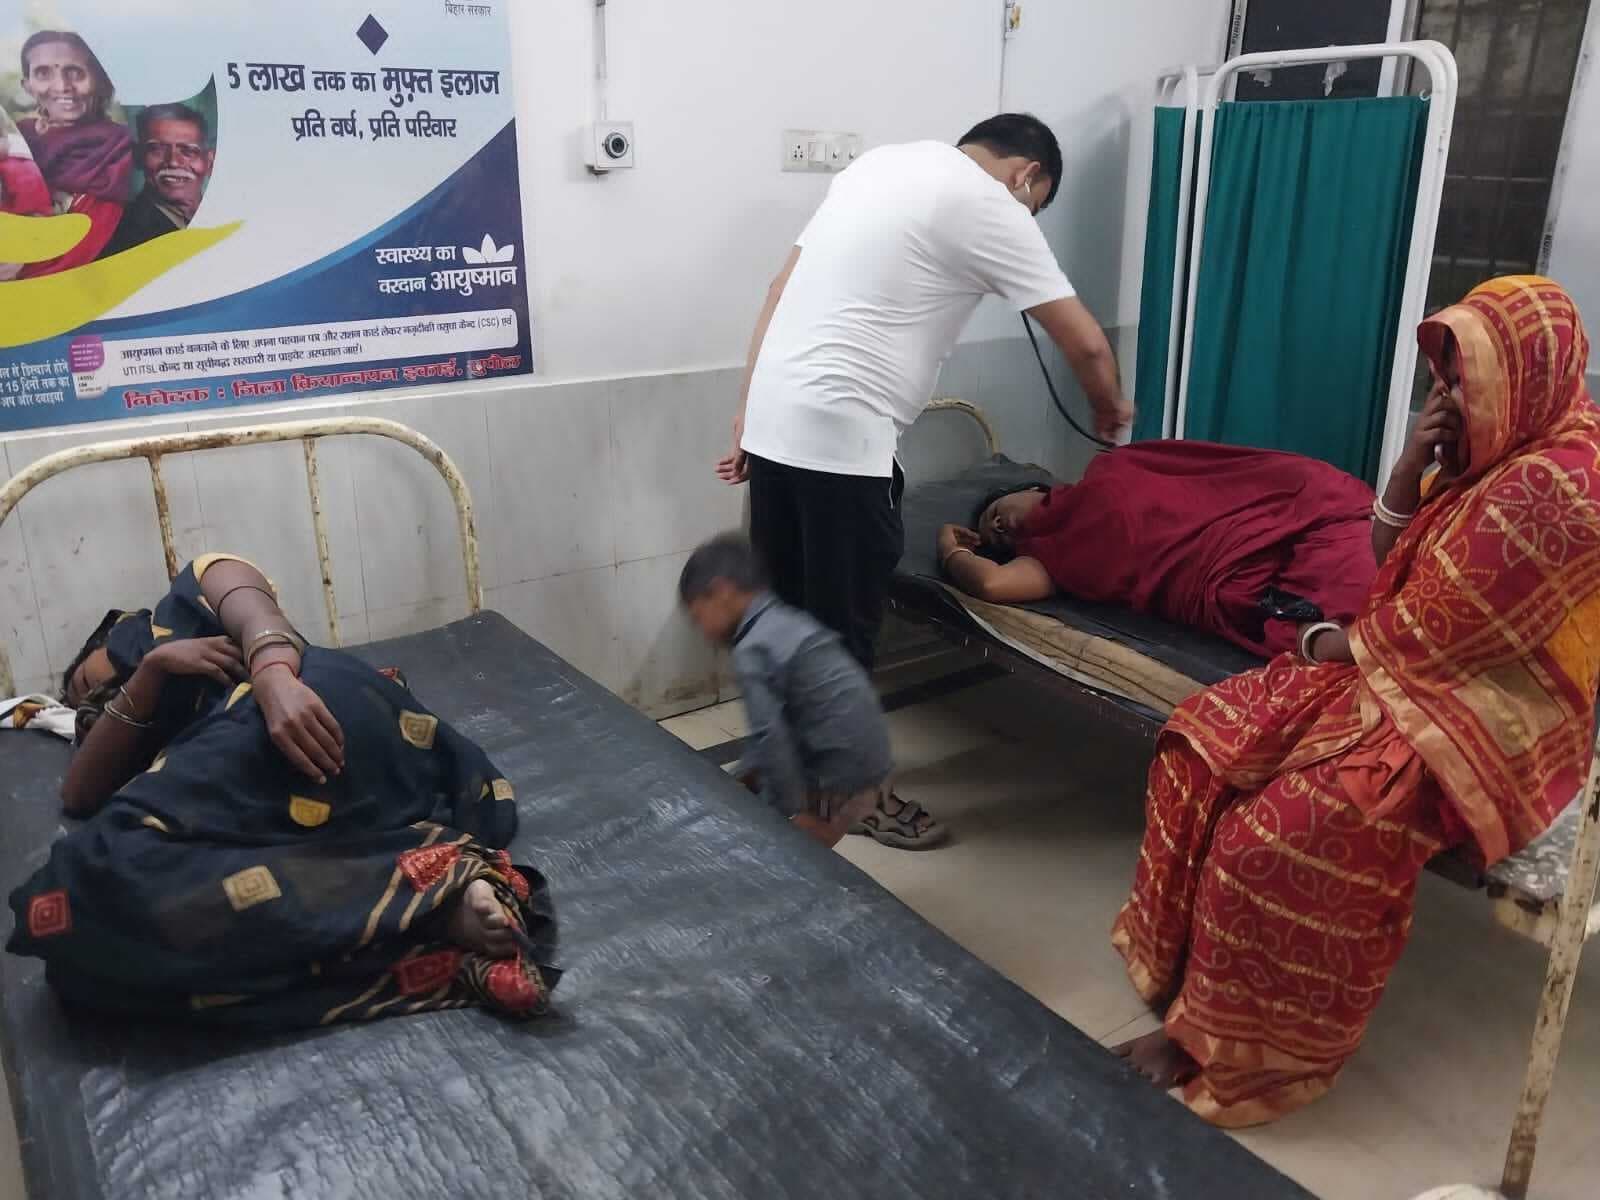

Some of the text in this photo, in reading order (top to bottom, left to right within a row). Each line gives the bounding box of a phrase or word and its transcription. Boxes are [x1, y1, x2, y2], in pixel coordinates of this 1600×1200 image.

[467, 5, 491, 17] सरकार
[227, 62, 240, 89] 5
[246, 62, 305, 92] लाख
[312, 70, 346, 92] तक
[351, 71, 376, 93] का
[438, 69, 500, 98] इलाज
[291, 108, 456, 141] प्रति वर्ष, प्रति परिवार
[375, 245, 456, 264] स्वास्थ्य का
[378, 266, 518, 296] वरदान आयुष्मान
[121, 347, 162, 361] आयुष्मान
[231, 338, 250, 350] लिए
[477, 315, 500, 329] (CSC)
[183, 360, 194, 371] या
[267, 353, 276, 364] या
[123, 387, 210, 410] निवेदक
[231, 379, 287, 400] जिला
